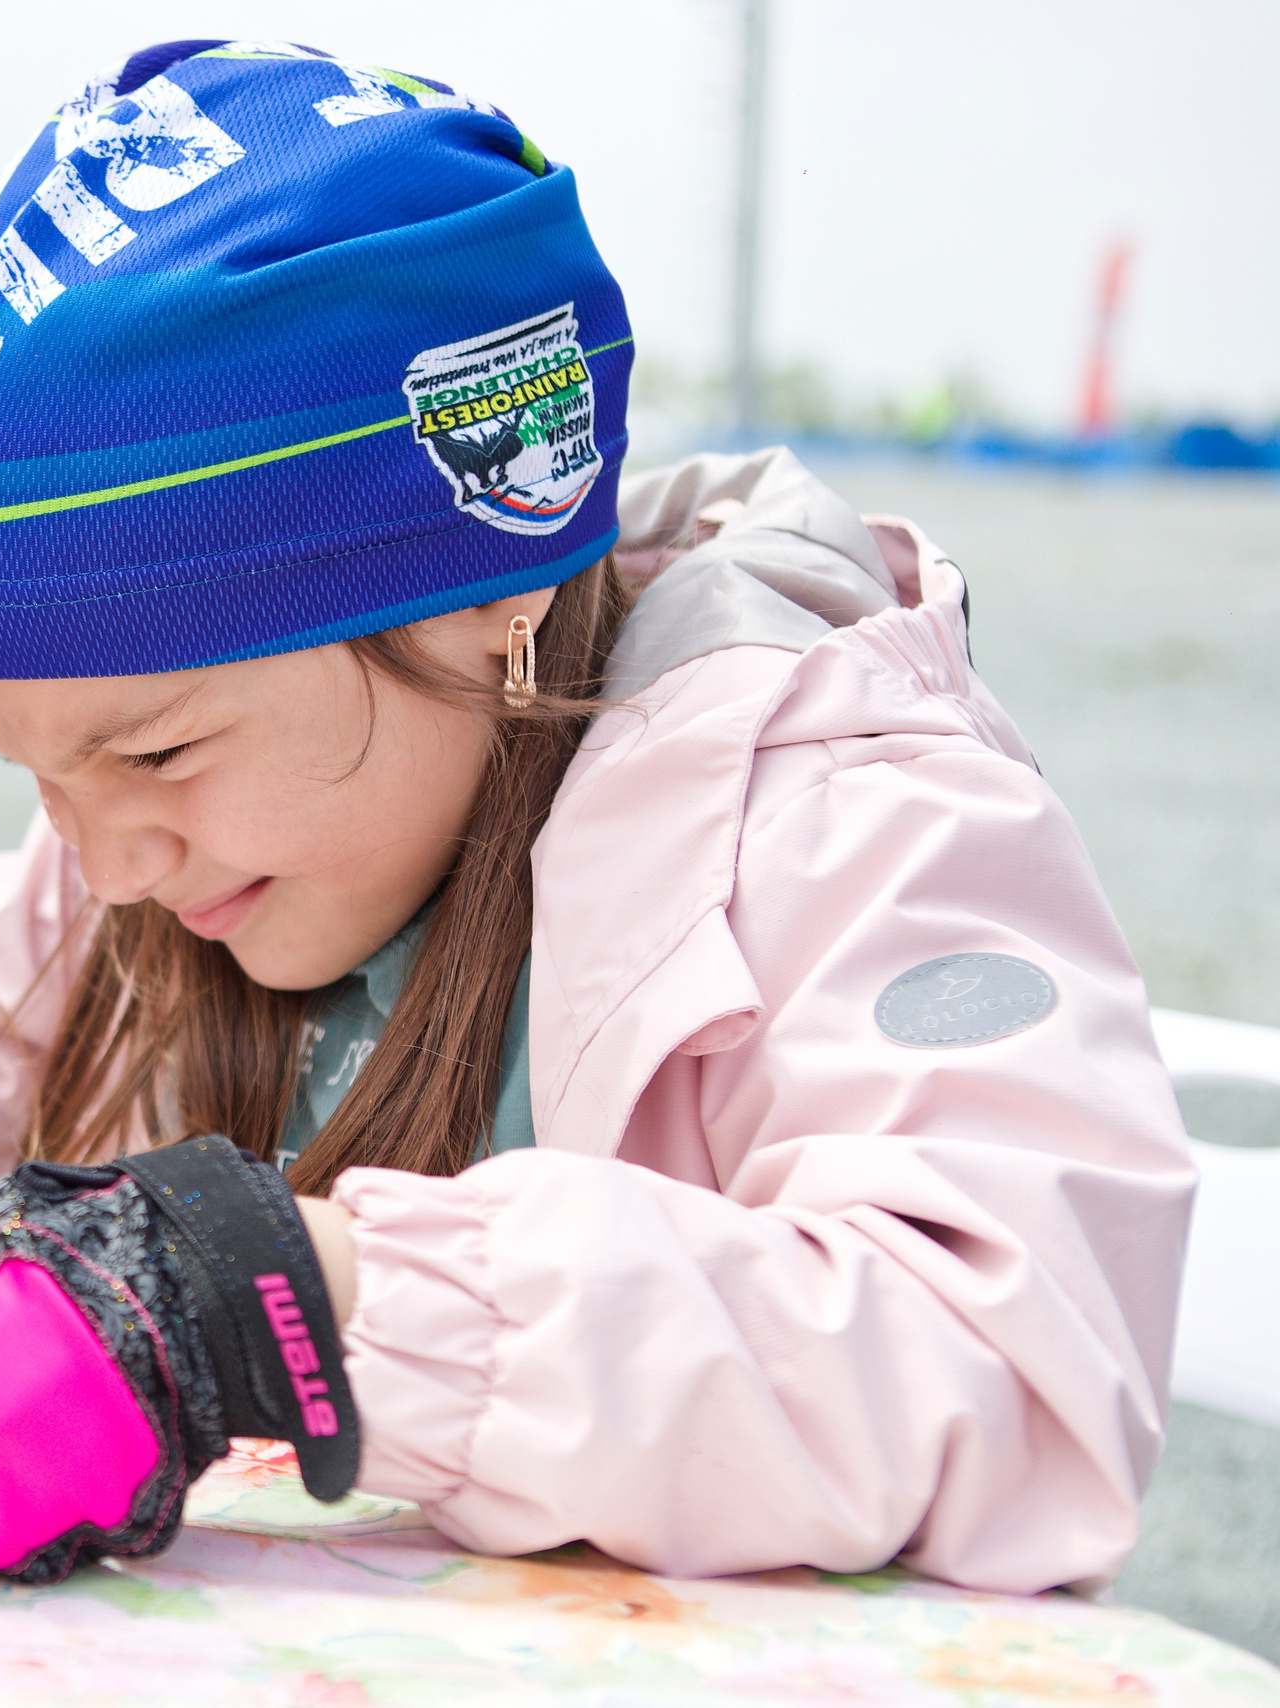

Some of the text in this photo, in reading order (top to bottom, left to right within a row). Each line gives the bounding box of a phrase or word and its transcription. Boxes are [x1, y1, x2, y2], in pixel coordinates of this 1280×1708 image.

[409, 360, 490, 390] Presentation
[416, 348, 577, 411] CHALLENGE
[419, 360, 587, 436] RAINFOREST
[539, 393, 590, 424] SAKHALIN
[545, 411, 590, 447] RUSSIA
